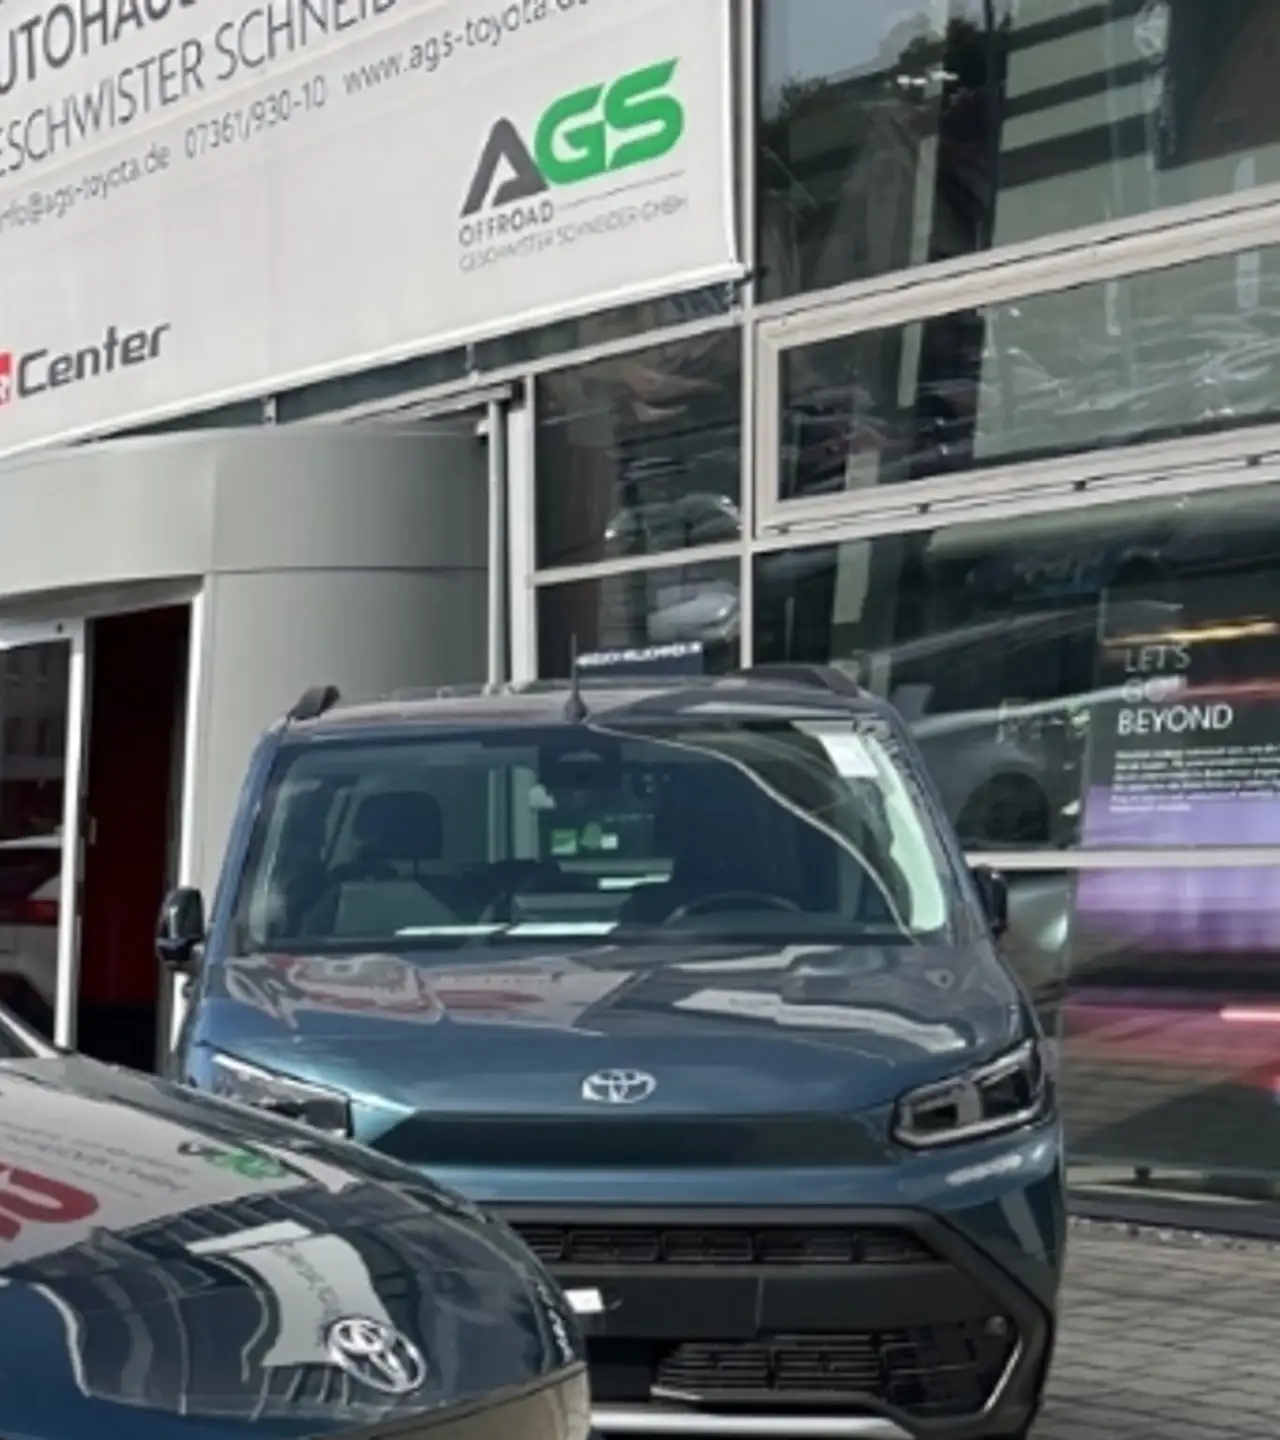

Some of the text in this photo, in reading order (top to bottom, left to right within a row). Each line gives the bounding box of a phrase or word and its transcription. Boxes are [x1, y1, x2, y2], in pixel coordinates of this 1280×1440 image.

[183, 74, 329, 159] 07361/930-10
[342, 0, 589, 95] www.ags-toyota.
[458, 55, 685, 219] AGS
[458, 200, 554, 247] OFFROAD
[16, 322, 172, 399] Center
[1116, 702, 1235, 735] BEYOND
